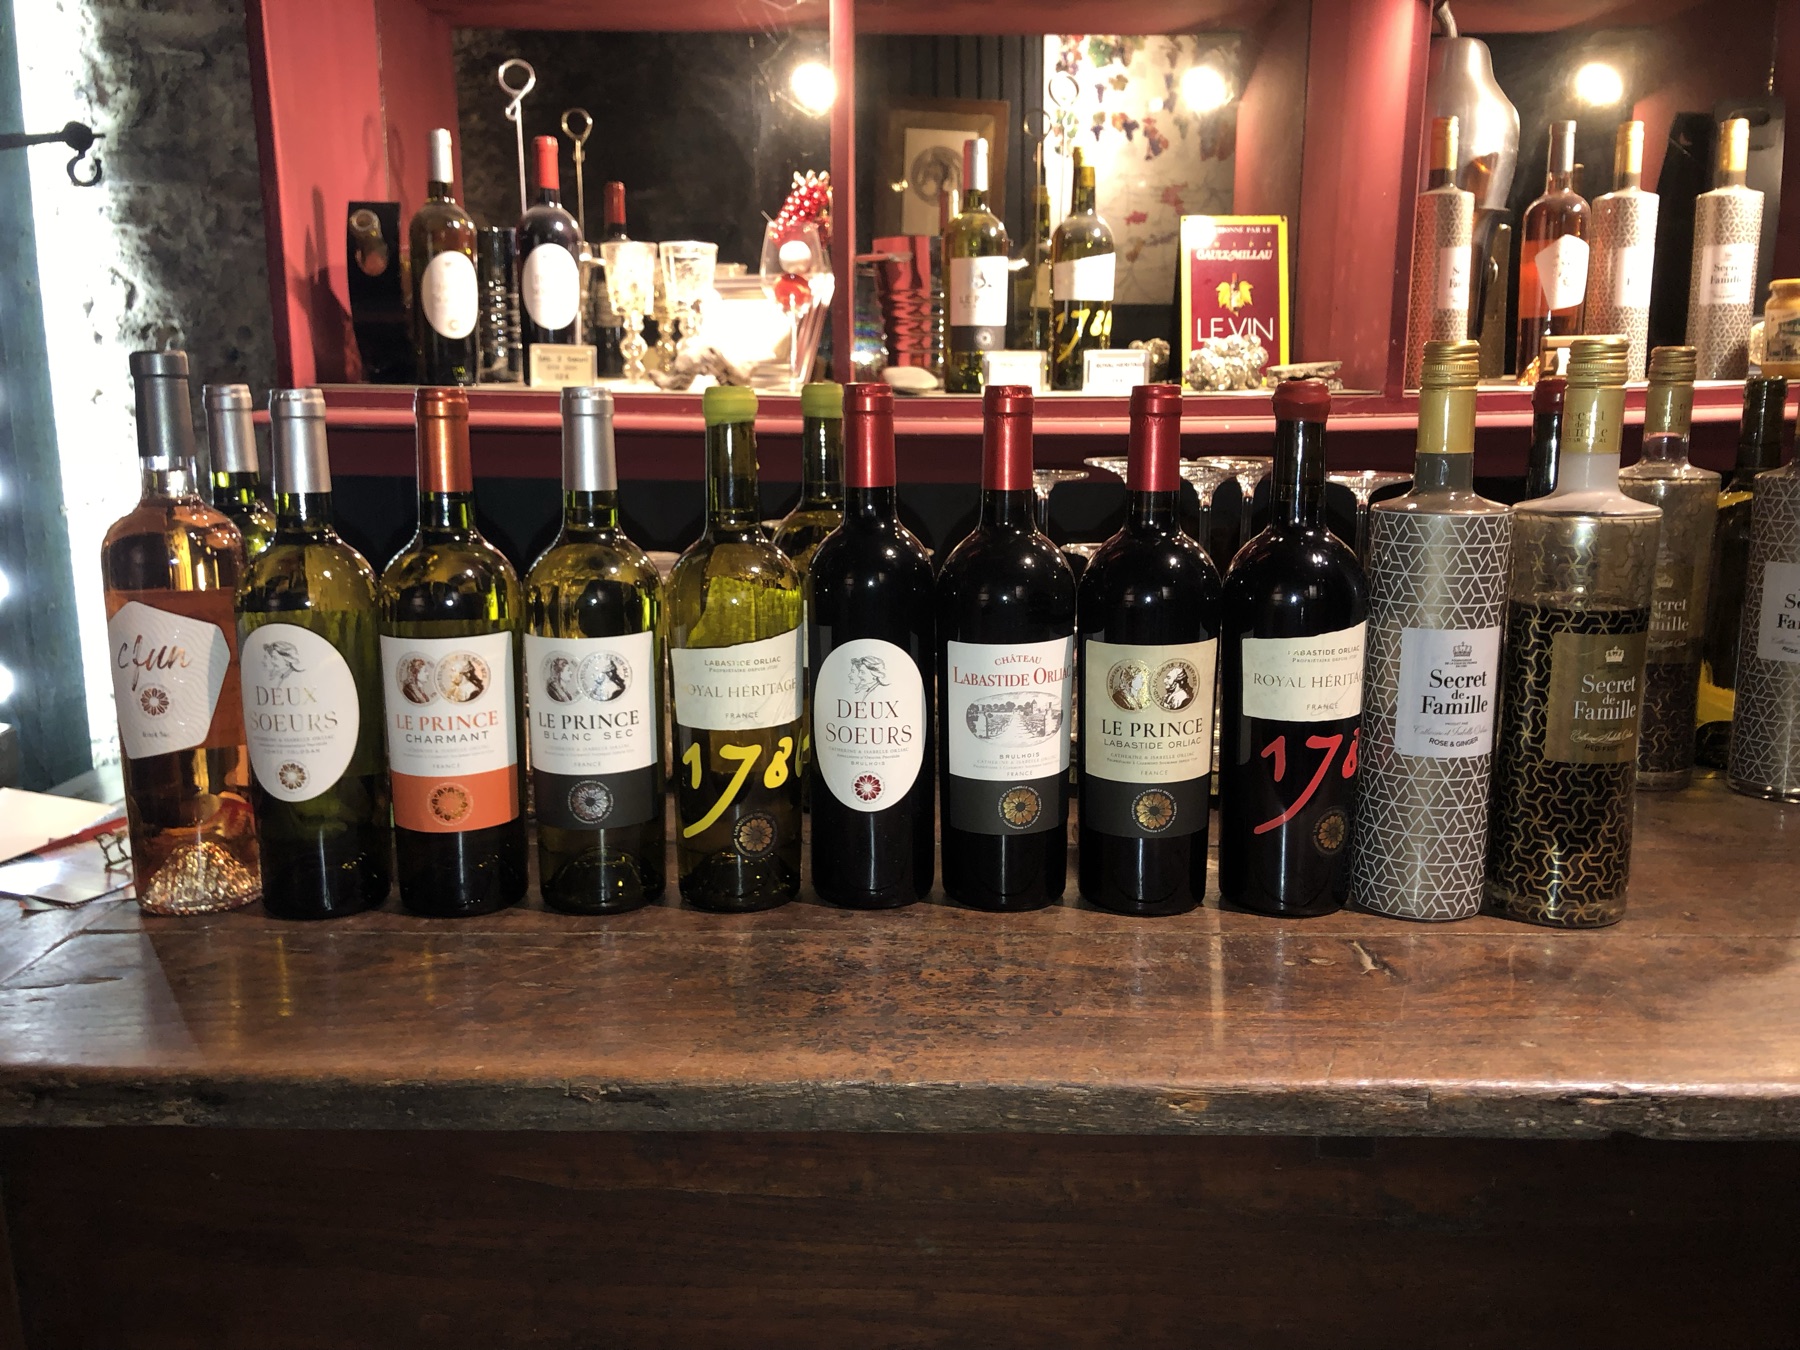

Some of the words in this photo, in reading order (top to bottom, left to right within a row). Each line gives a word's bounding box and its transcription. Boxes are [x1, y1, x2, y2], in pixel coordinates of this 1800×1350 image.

[1197, 317, 1224, 342] LE
[1228, 317, 1273, 341] VIN
[1338, 645, 1360, 654] ORLIAC
[754, 656, 781, 665] ORLIAC
[994, 654, 1042, 666] CHÂTEAU
[953, 665, 1030, 687] LABASTIDE
[1033, 664, 1071, 684] ORLIAC
[1253, 672, 1306, 688] ROYAL
[1429, 669, 1487, 688] Secret
[1581, 673, 1636, 693] Secret
[256, 686, 317, 706] DEUX
[685, 684, 723, 698] OYAL
[1451, 689, 1464, 700] de
[1602, 694, 1615, 705] de
[837, 699, 899, 719] DEUX
[1306, 702, 1339, 710] FRANCE
[1420, 694, 1488, 715] Famille
[1573, 699, 1637, 720] Famille
[250, 711, 338, 733] SOEURS
[395, 714, 413, 731] LE
[419, 710, 499, 732] PRINCE
[539, 712, 555, 729] LE
[561, 709, 640, 730] PRINCE
[725, 711, 759, 719] FRANCE
[543, 730, 592, 742] BLANC
[603, 728, 634, 740] SEC
[826, 722, 912, 746] SOEURS
[1102, 719, 1122, 736] LE
[1130, 718, 1203, 737] PRINCE
[405, 730, 488, 744] CHARMANT
[1104, 739, 1163, 749] LABASTIDE
[1168, 737, 1201, 749] ORLIAC
[1429, 737, 1448, 747] ROSE
[1456, 736, 1478, 747] GINGER
